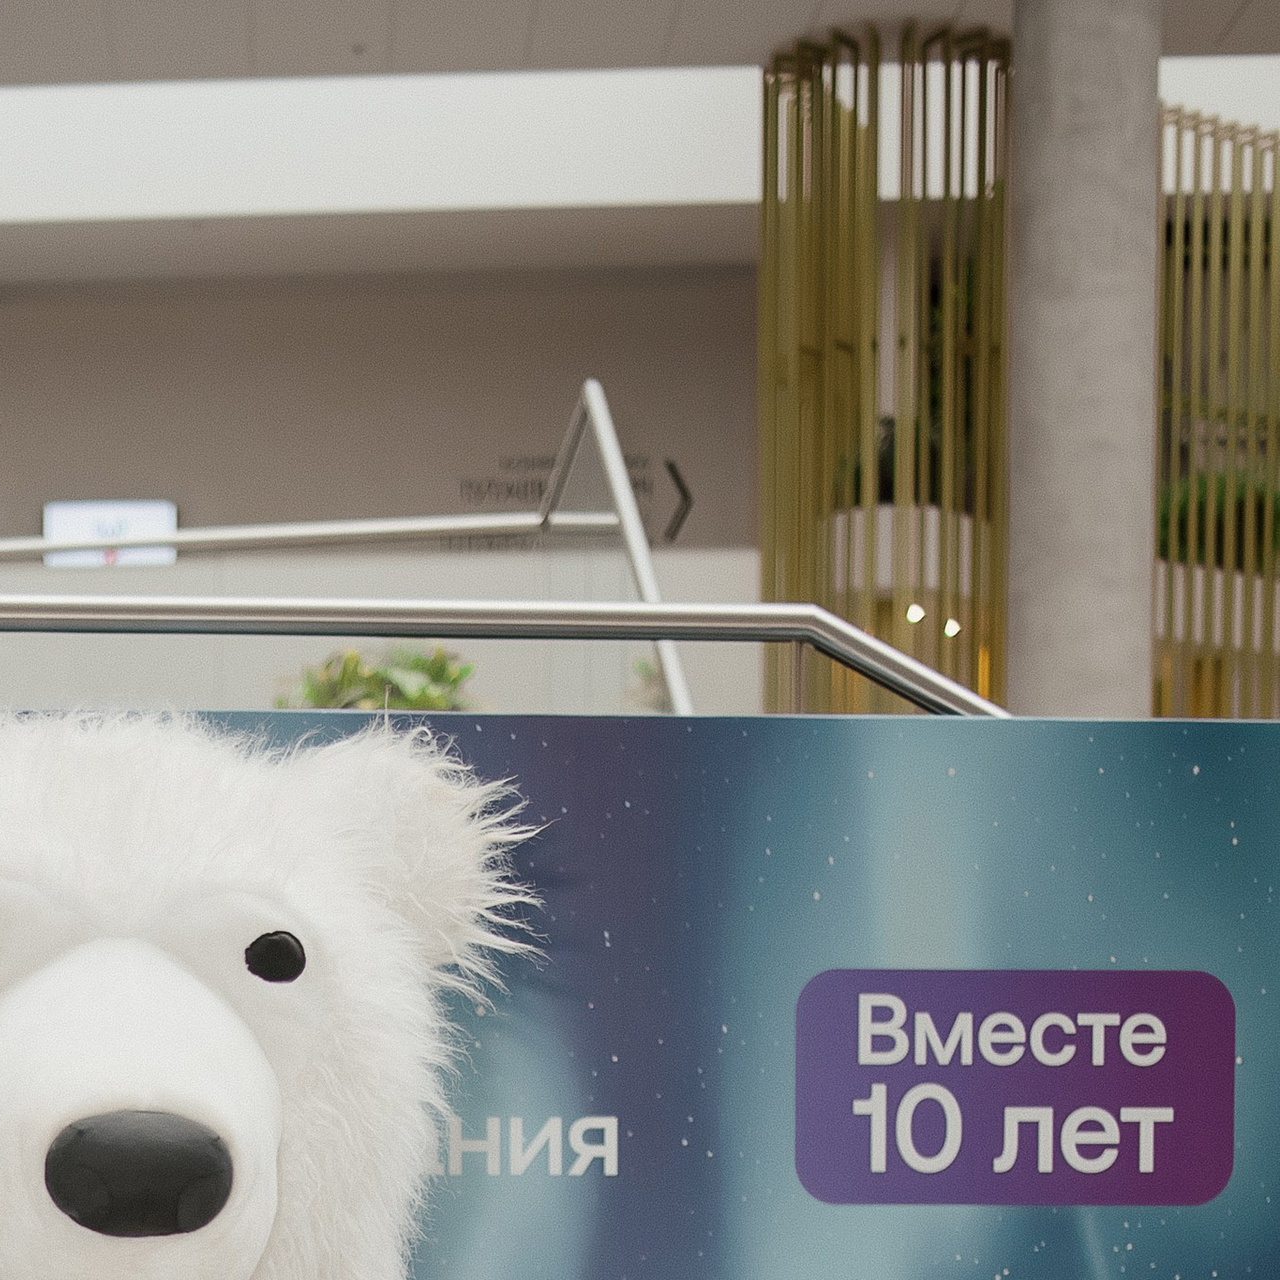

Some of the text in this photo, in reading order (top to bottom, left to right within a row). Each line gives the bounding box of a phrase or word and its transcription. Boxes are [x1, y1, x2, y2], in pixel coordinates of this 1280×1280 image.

[857, 992, 1168, 1067] Вместе
[429, 1115, 619, 1177] ния
[852, 1081, 1175, 1174] 10 лет
